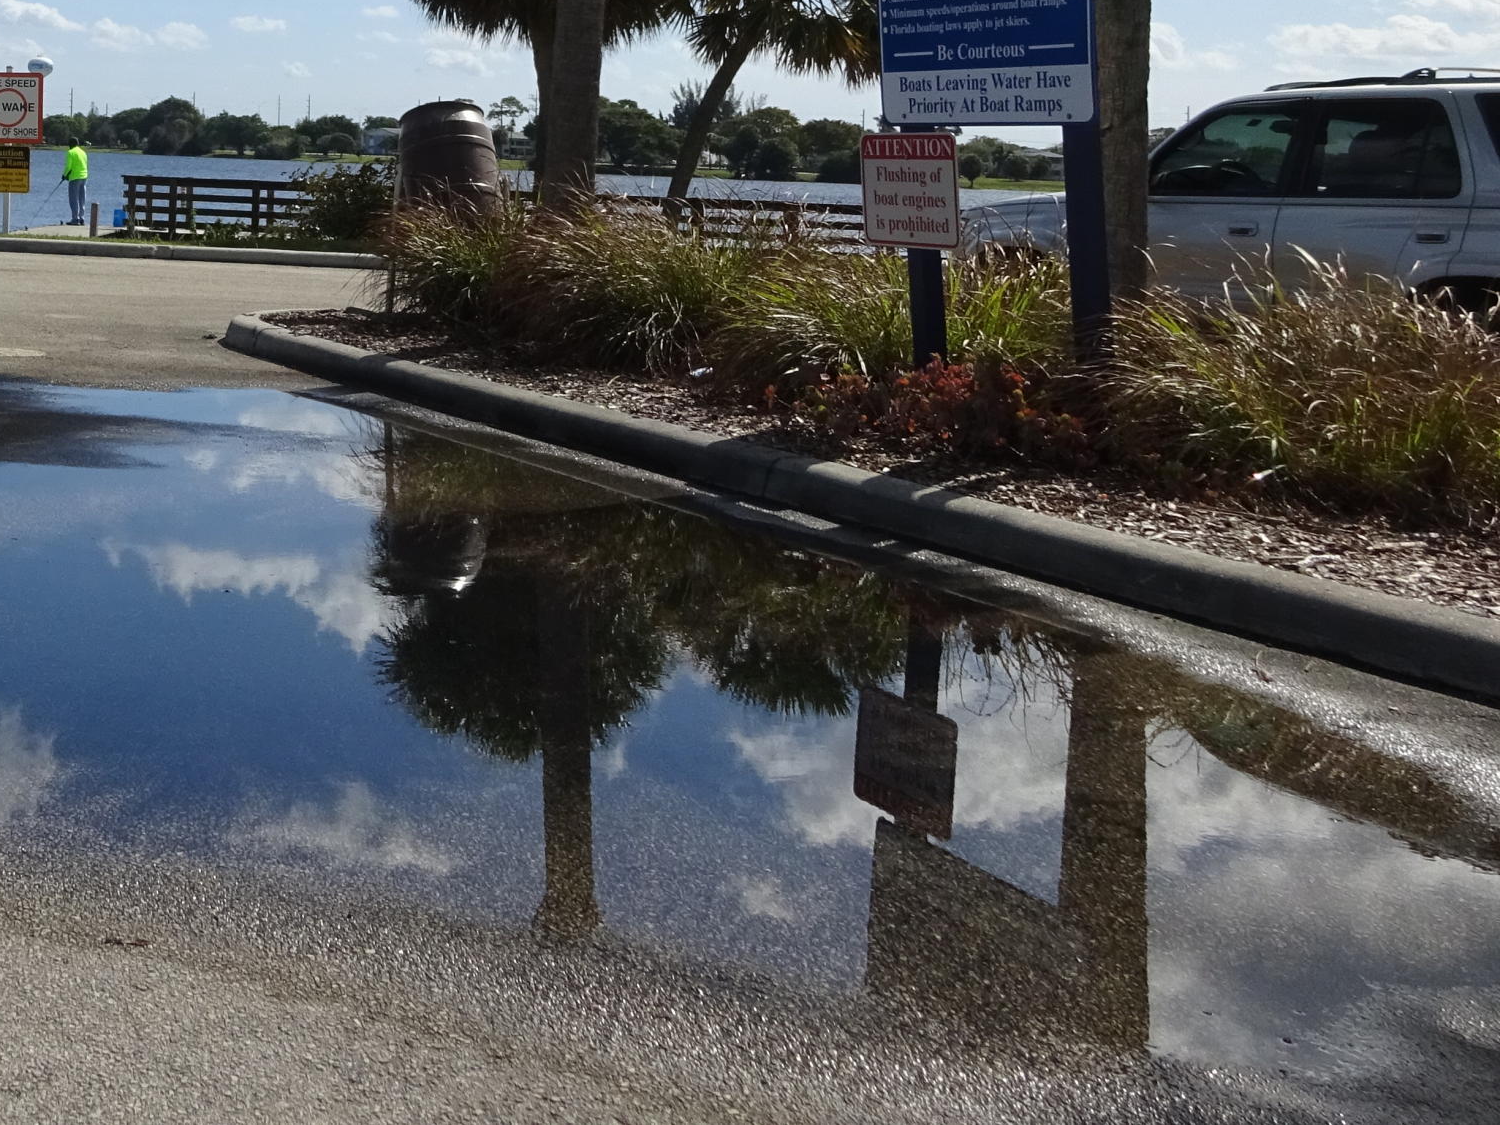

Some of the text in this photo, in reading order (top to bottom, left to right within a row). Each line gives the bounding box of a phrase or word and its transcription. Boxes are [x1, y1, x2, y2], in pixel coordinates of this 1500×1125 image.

[889, 7, 925, 18] Minimum
[926, 1, 990, 18] speeds/operations
[890, 16, 1030, 34] Florida boating laws apply to jet skiers.
[937, 43, 1026, 61] Be Courteous
[5, 79, 37, 88] SPEED
[899, 71, 1071, 95] Boats Leaving Water Have
[1, 102, 36, 113] WAKE
[908, 95, 1063, 117] Priority At Boat Ramps
[2, 127, 12, 136] OF
[13, 127, 38, 137] SHORE
[864, 138, 952, 156] ATTENTION
[876, 166, 943, 187] Flushing of
[874, 190, 947, 212] boat engines
[876, 214, 950, 235] is prohibited
